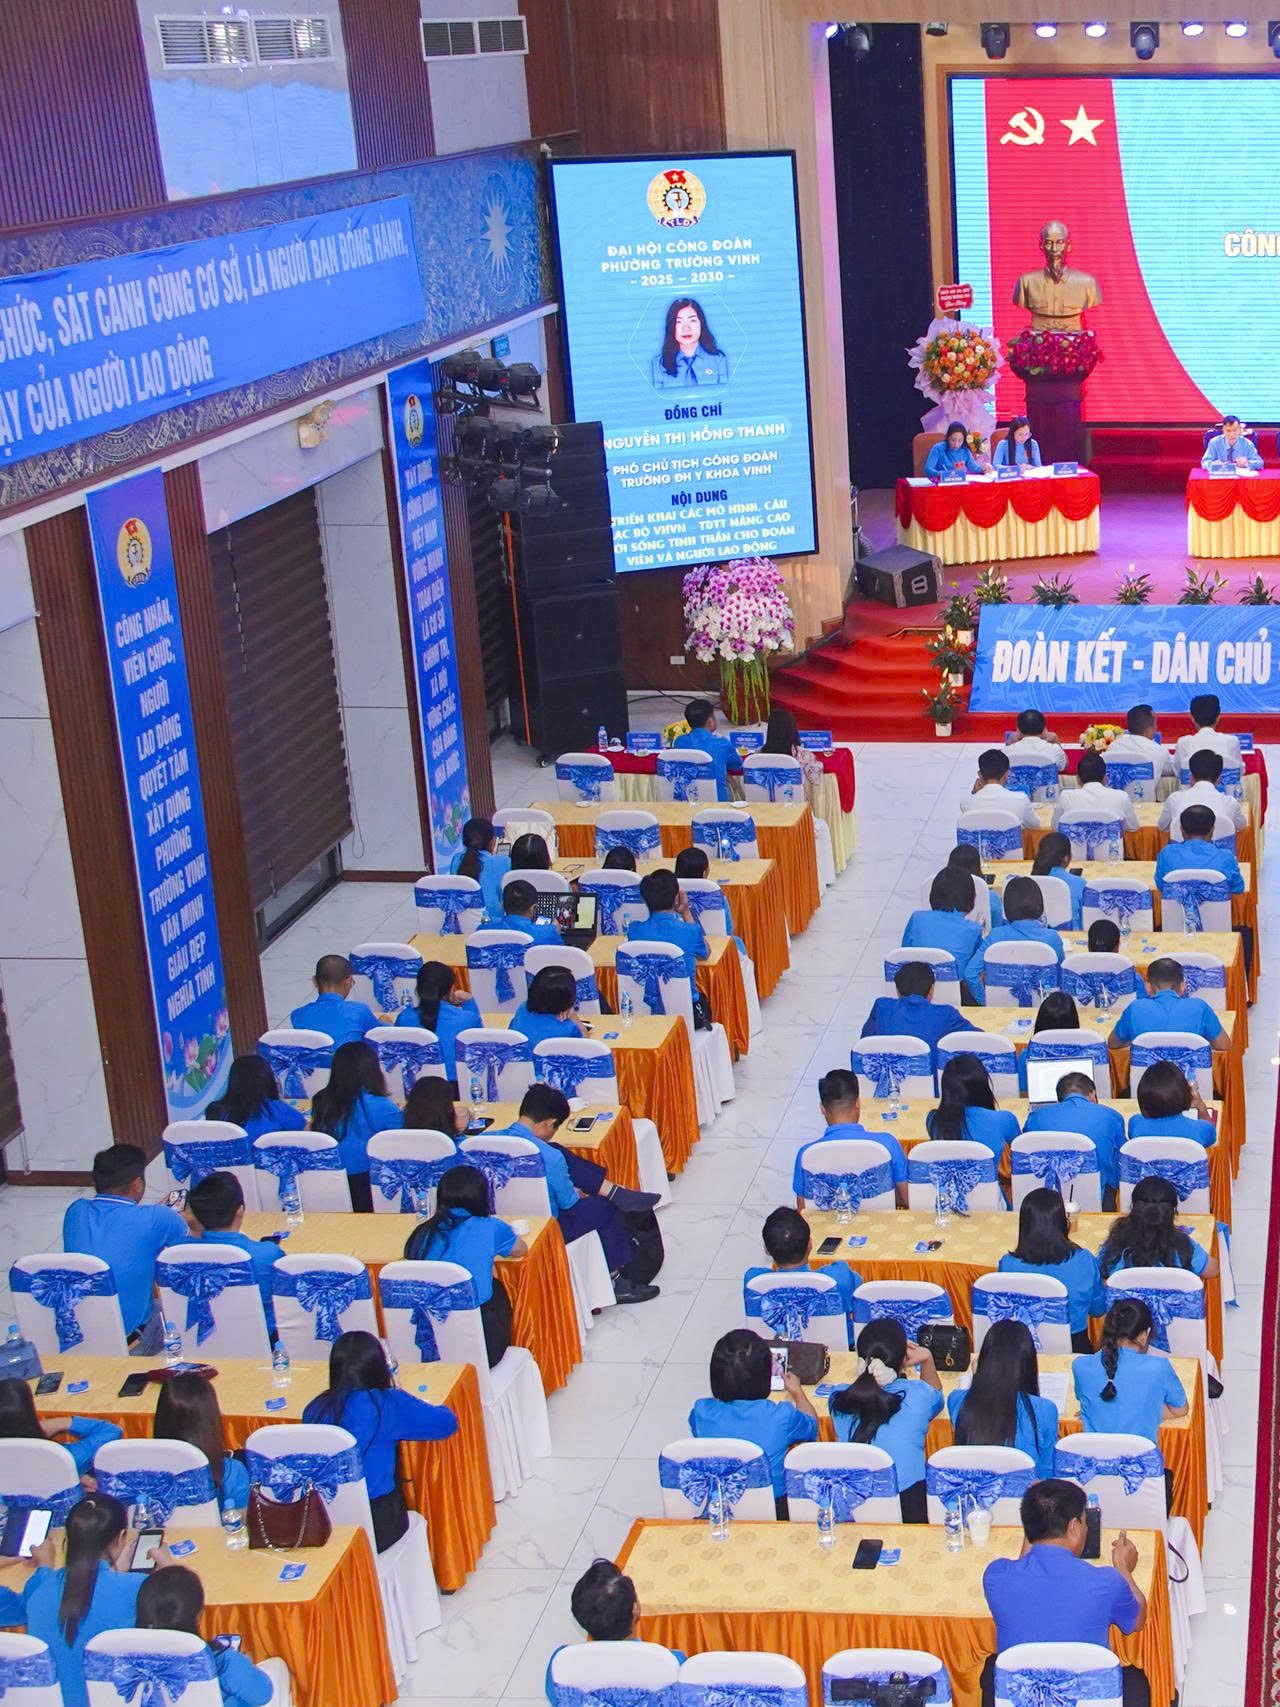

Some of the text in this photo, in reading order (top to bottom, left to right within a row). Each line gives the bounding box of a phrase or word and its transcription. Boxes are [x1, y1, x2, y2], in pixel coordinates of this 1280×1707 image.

[601, 253, 761, 273] PHƯỜNG TRƯỜNG VINH
[607, 238, 752, 259] ĐẠI HỘI CÔNG ĐOÀN
[0, 216, 408, 363] HỨC, SÁT CÁNH CÙNG CƠ SỞ, LÀ NGƯỜI BẠN ĐỒNG HÀNH,
[641, 271, 723, 286] 2025 2030
[26, 363, 72, 435] CỦA
[70, 350, 132, 421] NGƯỜI
[130, 349, 166, 402] LAO
[166, 332, 215, 396] ĐỘNG
[664, 402, 722, 421] ĐỒNG CHÍ
[603, 423, 785, 450] NGUYỄN THỊ HỒNG THANH
[613, 451, 778, 476] PHÓ CHỦ TỊCH CÔNG ĐOÀN
[620, 464, 772, 489] TRƯỜNG ĐH Y KHOA VINH
[647, 511, 676, 523] KHAI
[680, 506, 703, 519] CÁC
[706, 504, 725, 517] MÔ
[764, 498, 788, 511] CÂU
[671, 489, 728, 506] NỘI DUNG
[613, 529, 631, 541] ẠC
[653, 523, 687, 535] VHVN
[767, 512, 791, 523] CAO
[614, 543, 627, 554] ỜI
[668, 536, 696, 548] TINH
[734, 530, 759, 540] CHO
[762, 525, 795, 538] ĐOÀN
[627, 554, 653, 566] VIÊN
[676, 547, 714, 560] NGƯỜI
[718, 545, 740, 556] LAO
[114, 596, 174, 648] CÔNG NHÂN,
[123, 636, 176, 686] VIÊN CHỨC,
[992, 631, 1069, 684] ĐOÀN
[1075, 627, 1127, 684] KẾT
[1151, 632, 1208, 684] DÂN
[1216, 627, 1271, 685] CHỦ
[139, 675, 169, 718] NGƯỜI
[136, 712, 182, 762] LAO ĐỘNG
[139, 748, 189, 801] QUYẾT TÂM
[146, 785, 191, 837] XÂY DỰNG
[154, 825, 192, 871] PHƯỜNG
[149, 853, 207, 916] TRƯỜNG VINH
[160, 894, 204, 947] VĂN MINH
[168, 931, 206, 982] GIÀU ĐẸP
[166, 961, 216, 1022] NGHĨA TÌNH
